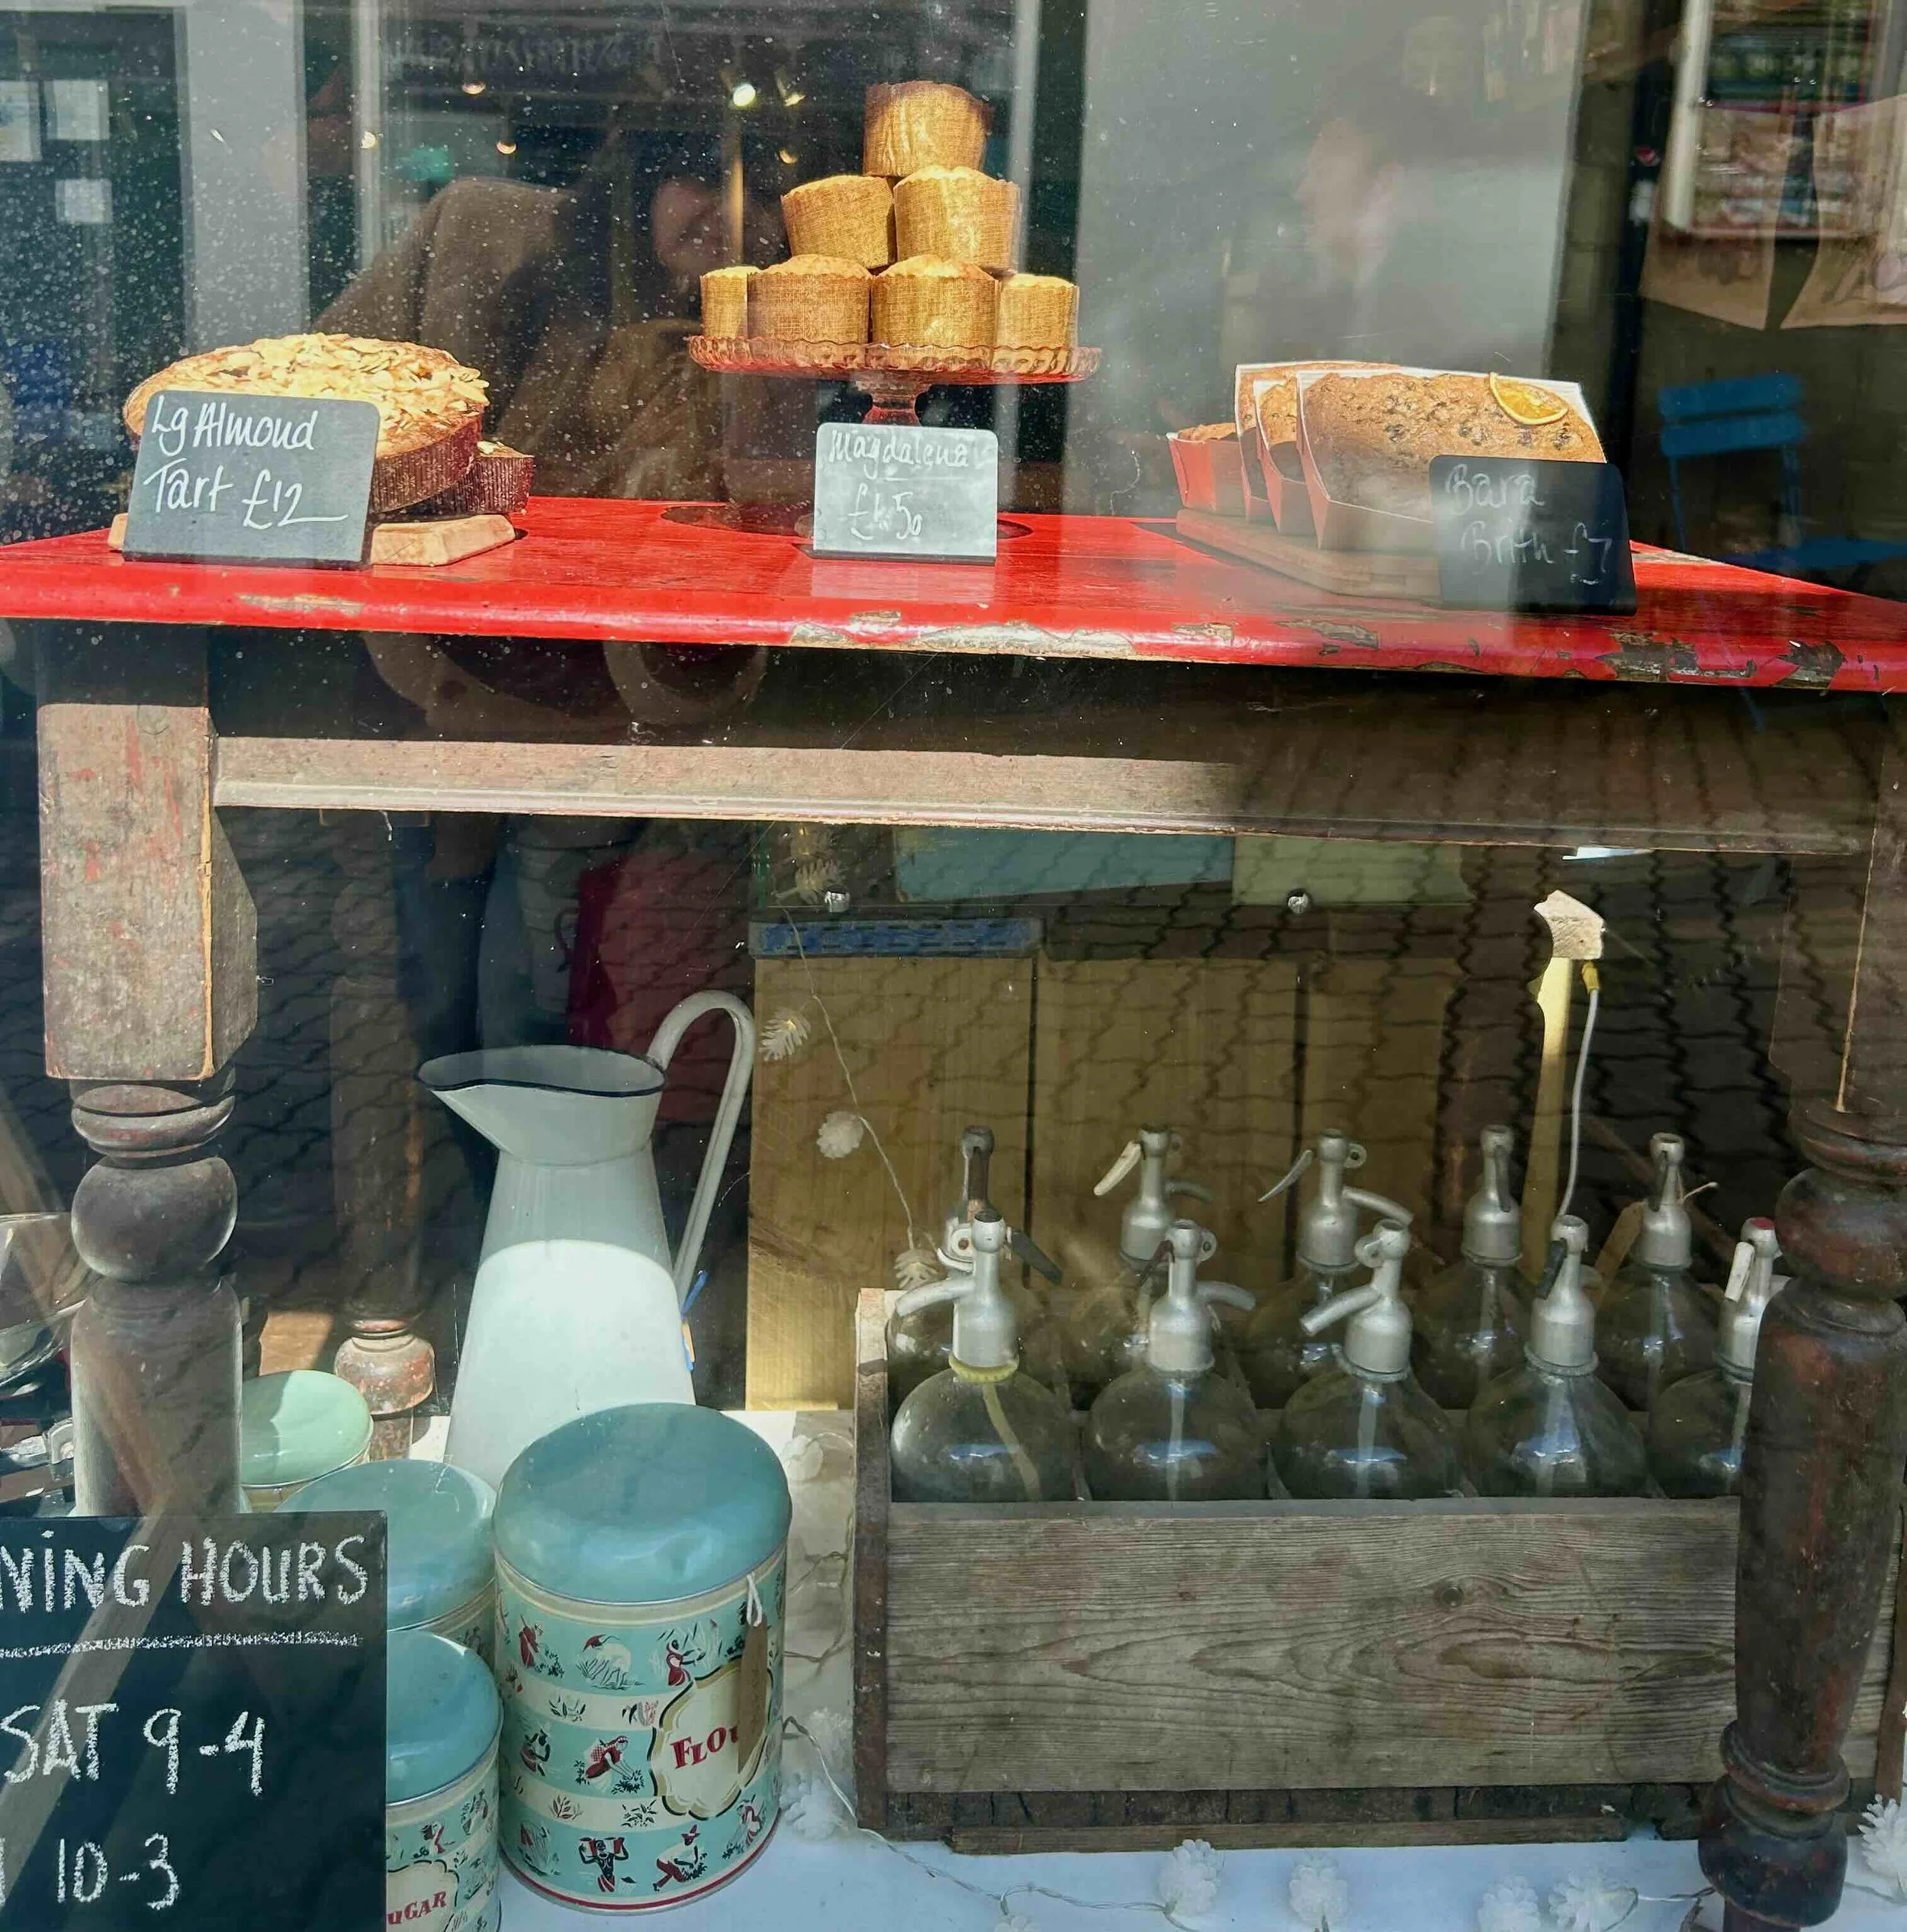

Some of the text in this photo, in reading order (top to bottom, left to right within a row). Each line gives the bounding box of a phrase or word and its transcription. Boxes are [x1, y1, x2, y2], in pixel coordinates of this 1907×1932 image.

[151, 394, 318, 458] Lg Almond
[143, 457, 349, 530] Tart £12
[1445, 463, 1546, 516] Bara
[180, 1534, 368, 1605] HOURS
[0, 1698, 120, 1784] SAT
[56, 1832, 180, 1910] 10-3
